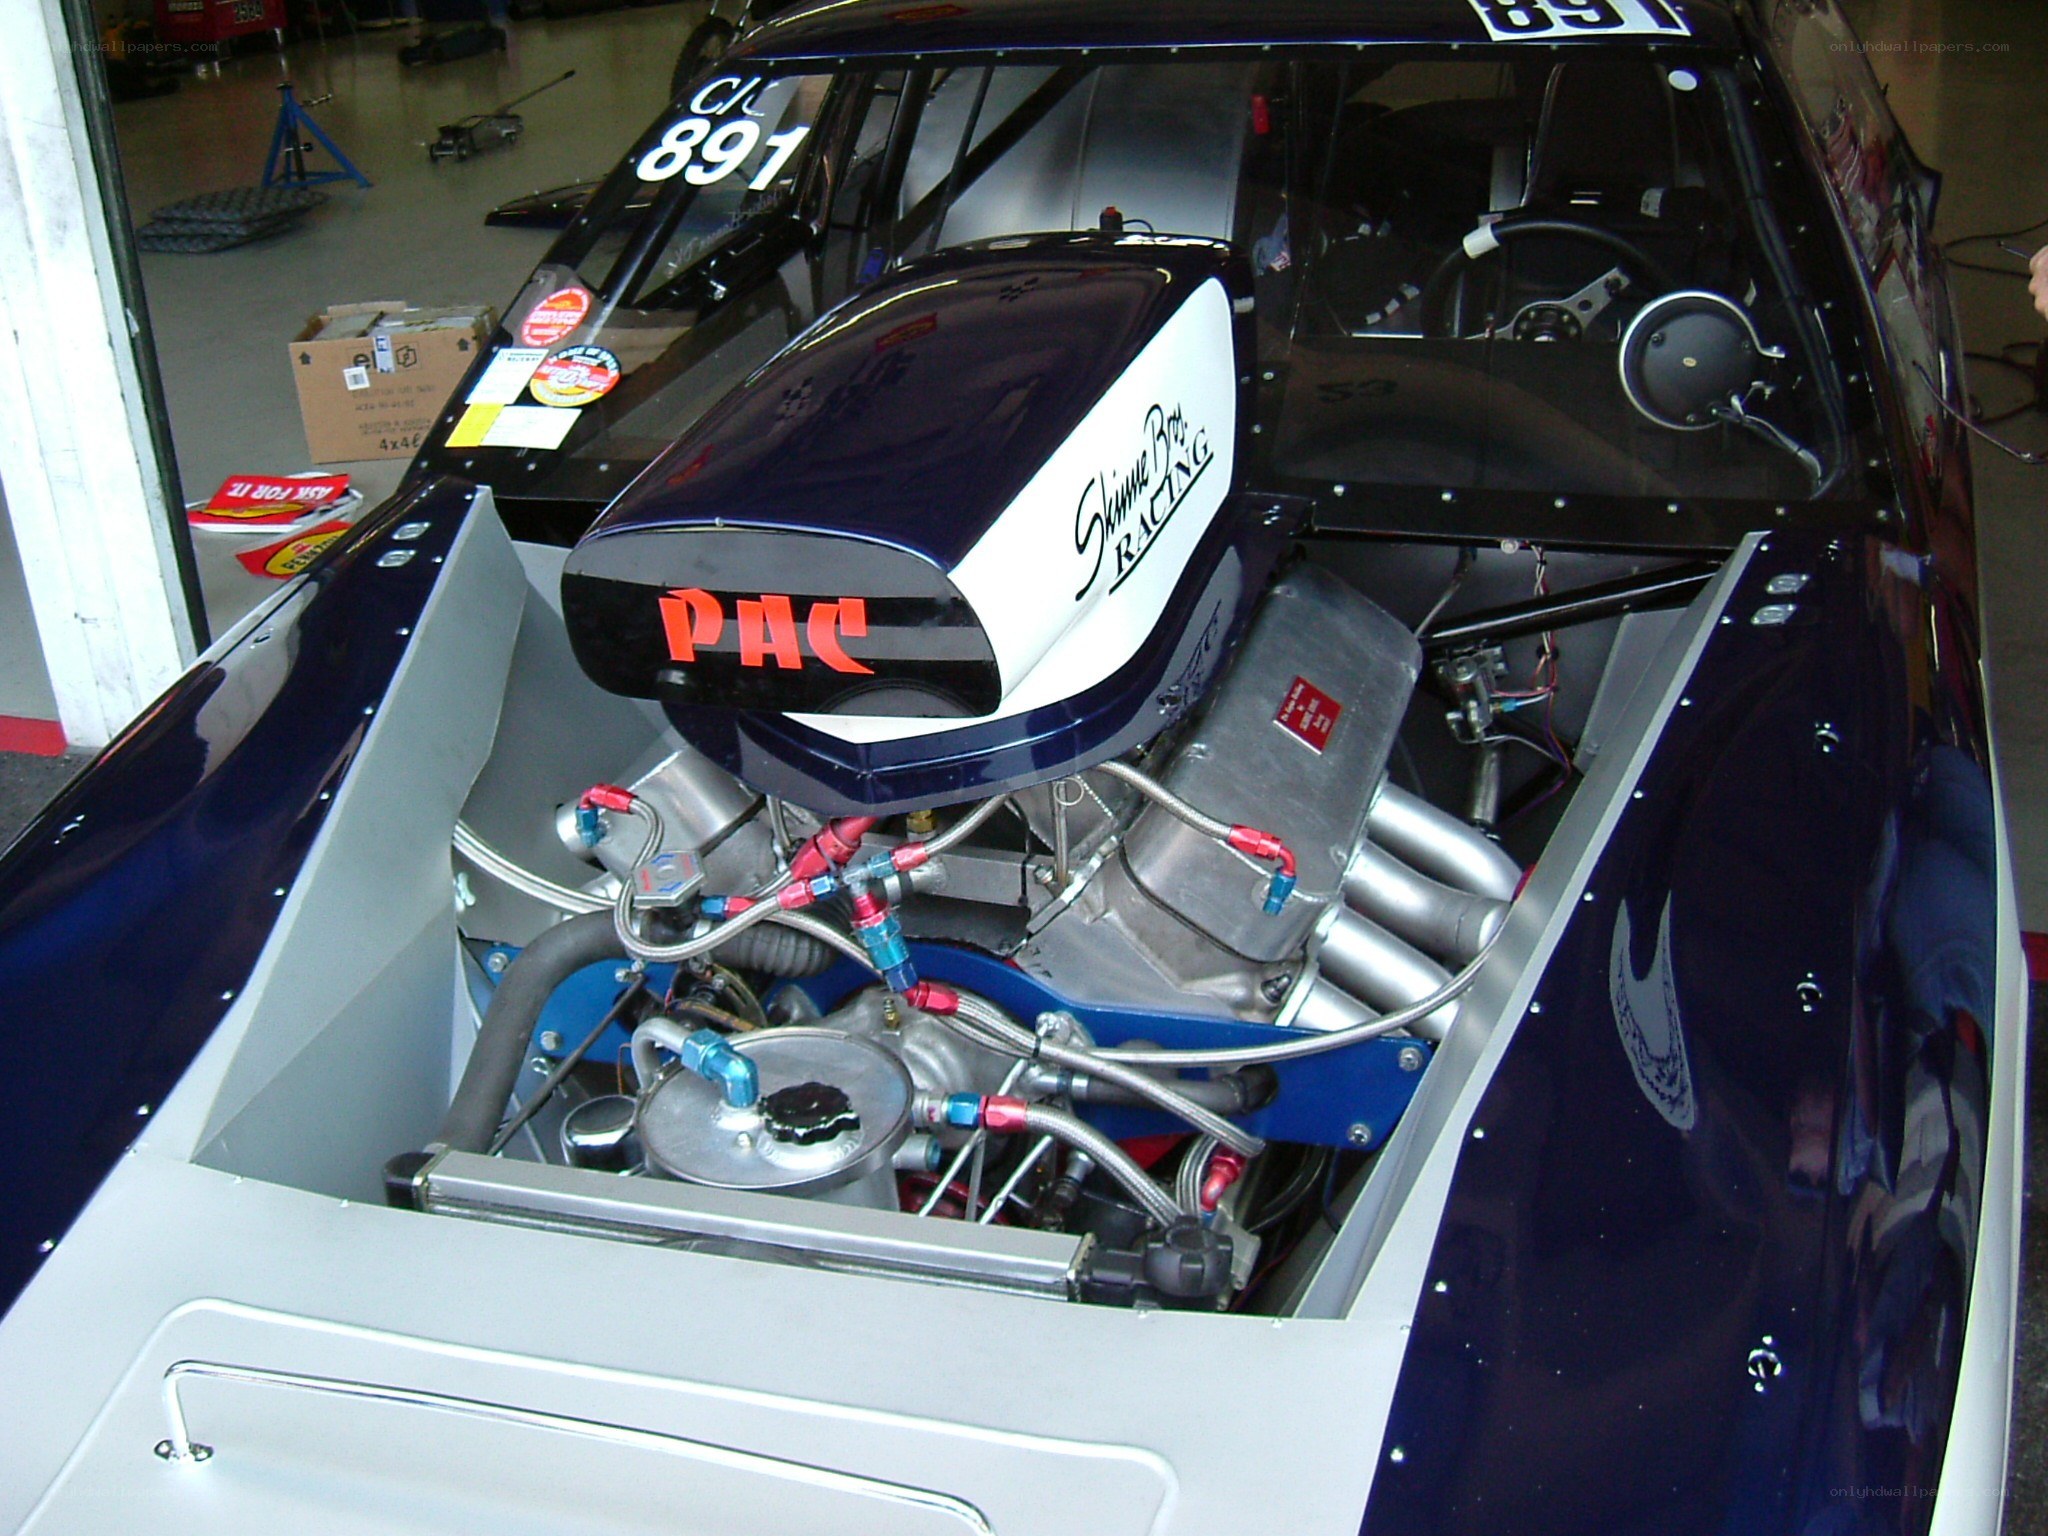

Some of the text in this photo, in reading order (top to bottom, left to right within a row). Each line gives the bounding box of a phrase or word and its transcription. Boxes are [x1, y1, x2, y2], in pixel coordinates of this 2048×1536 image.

[636, 118, 810, 191] 891
[251, 483, 294, 501] FOR
[291, 485, 335, 500] ASK
[1115, 426, 1210, 580] RACING
[658, 588, 875, 675] PAC
